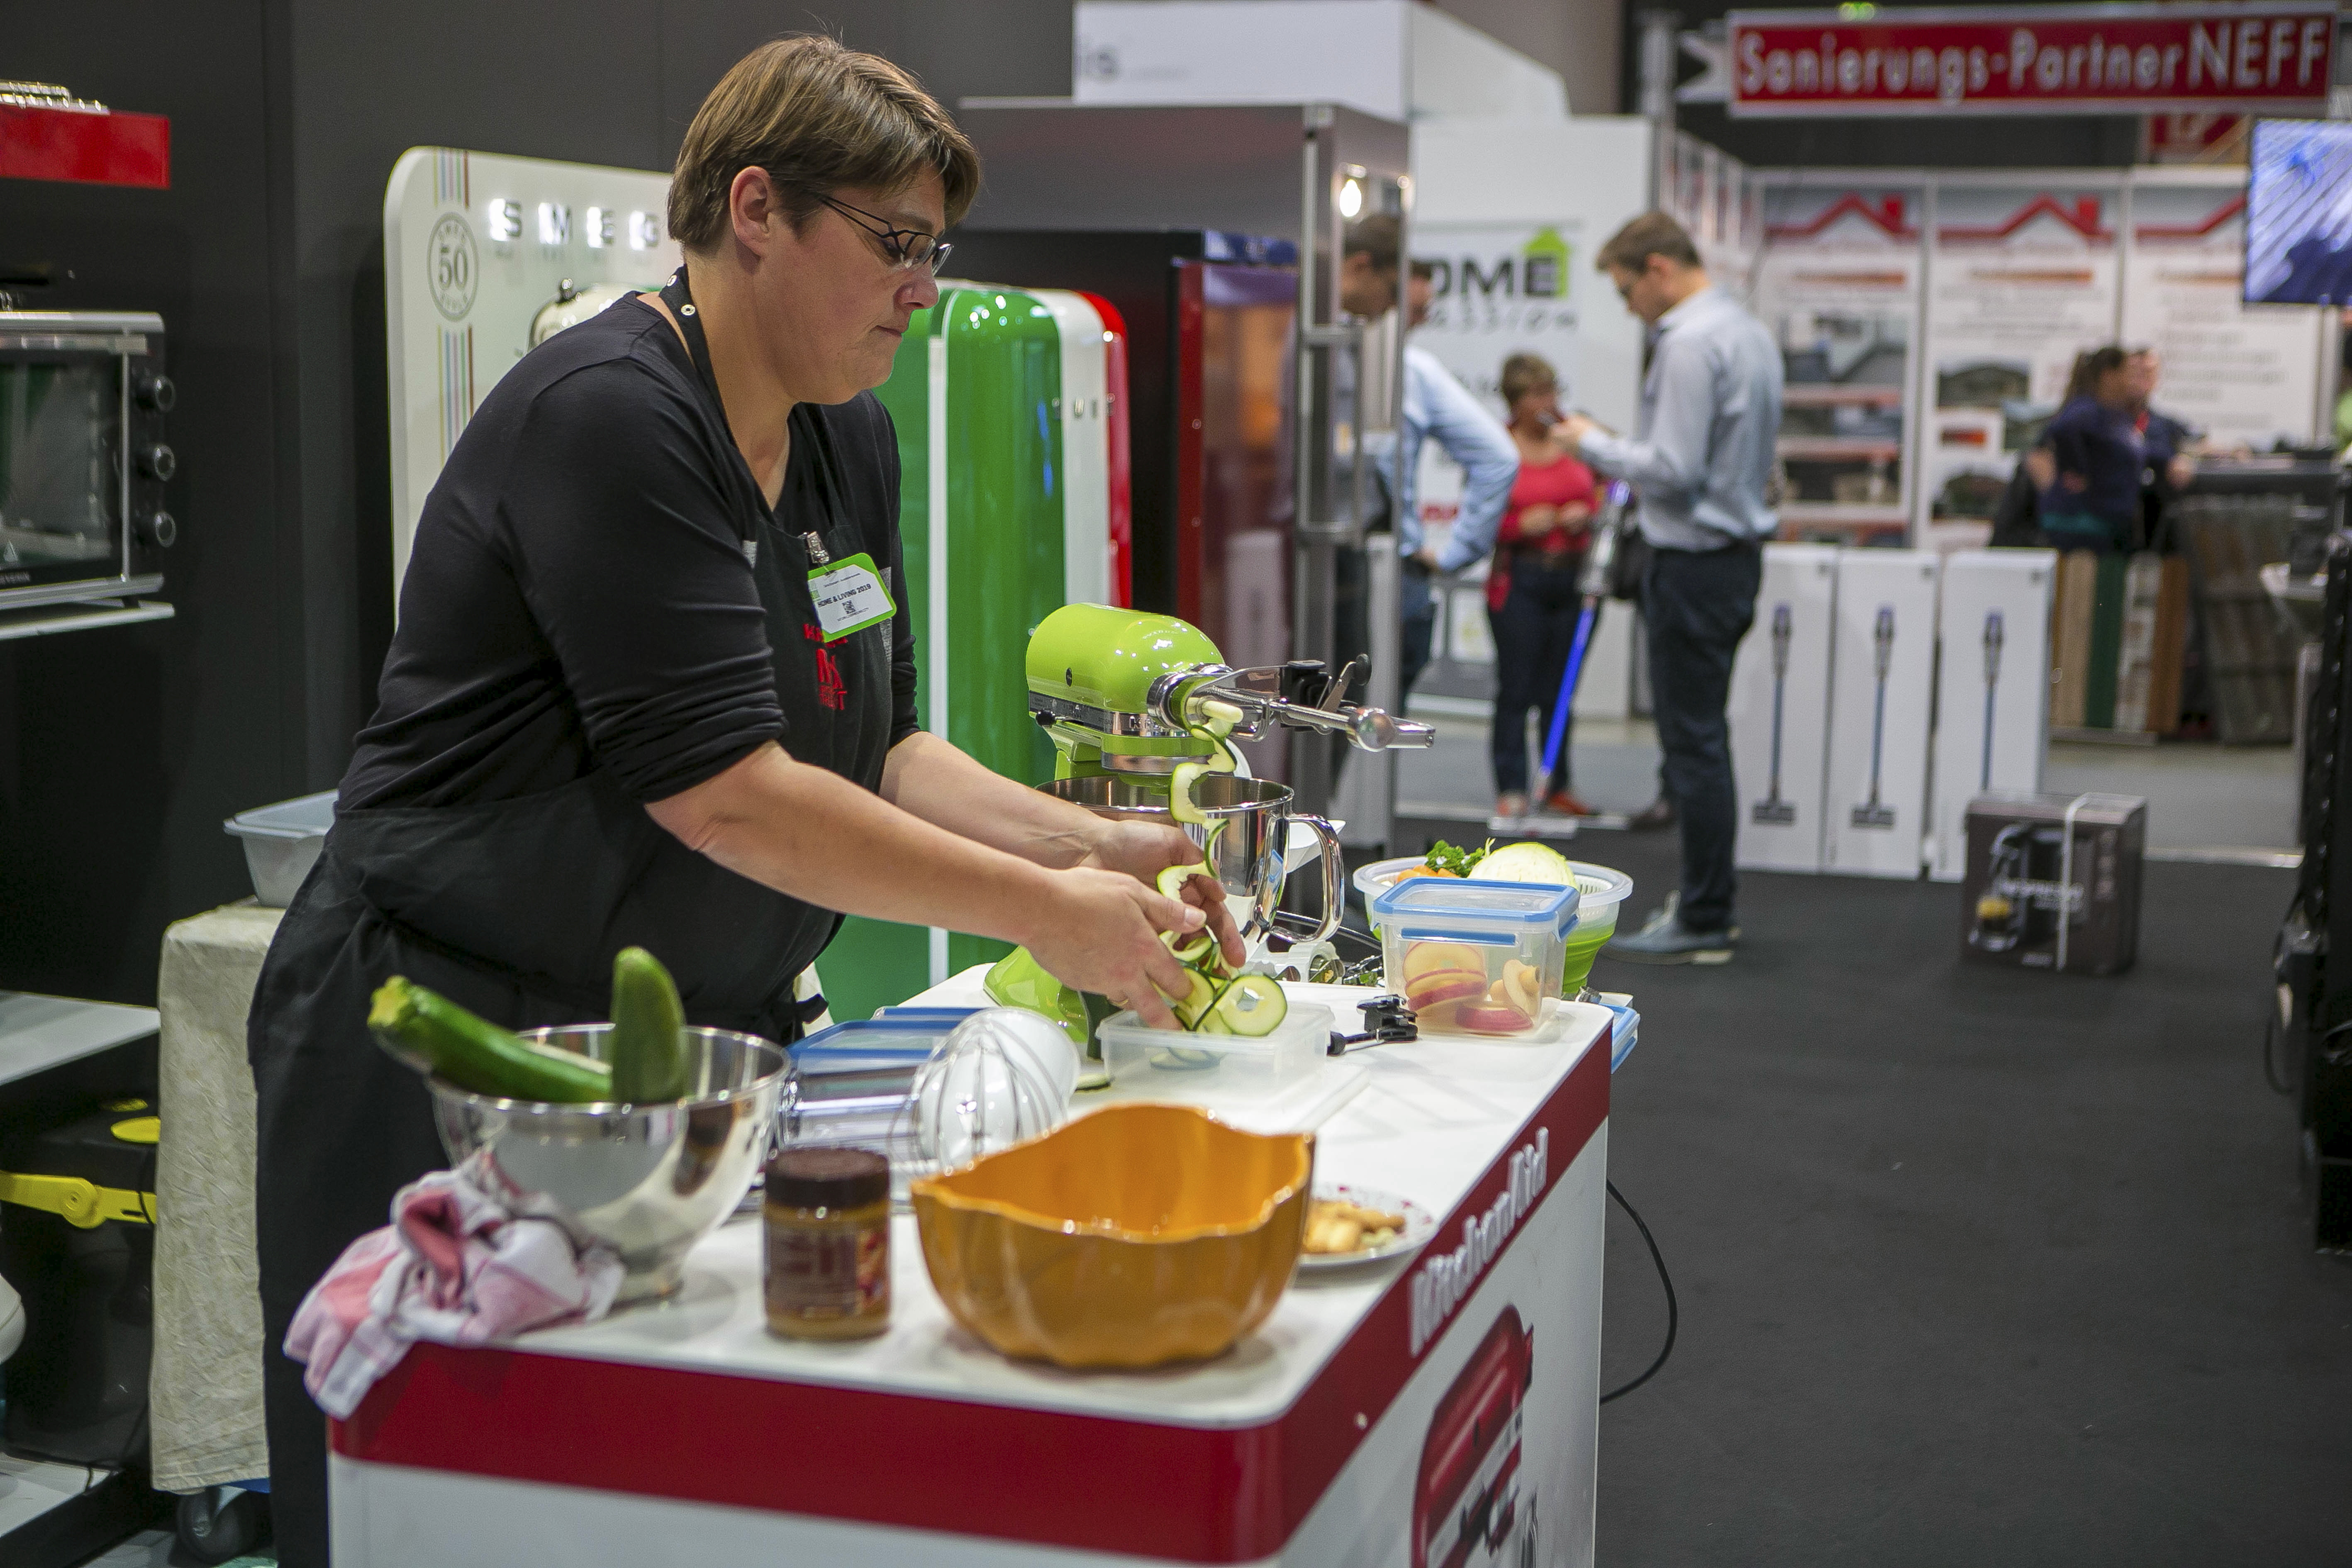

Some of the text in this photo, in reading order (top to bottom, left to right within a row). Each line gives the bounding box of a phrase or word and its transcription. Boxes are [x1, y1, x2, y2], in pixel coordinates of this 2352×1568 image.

[1741, 19, 2325, 106] Sanierungs-Partner NEFF
[439, 244, 468, 290] 50
[856, 584, 871, 593] 2019
